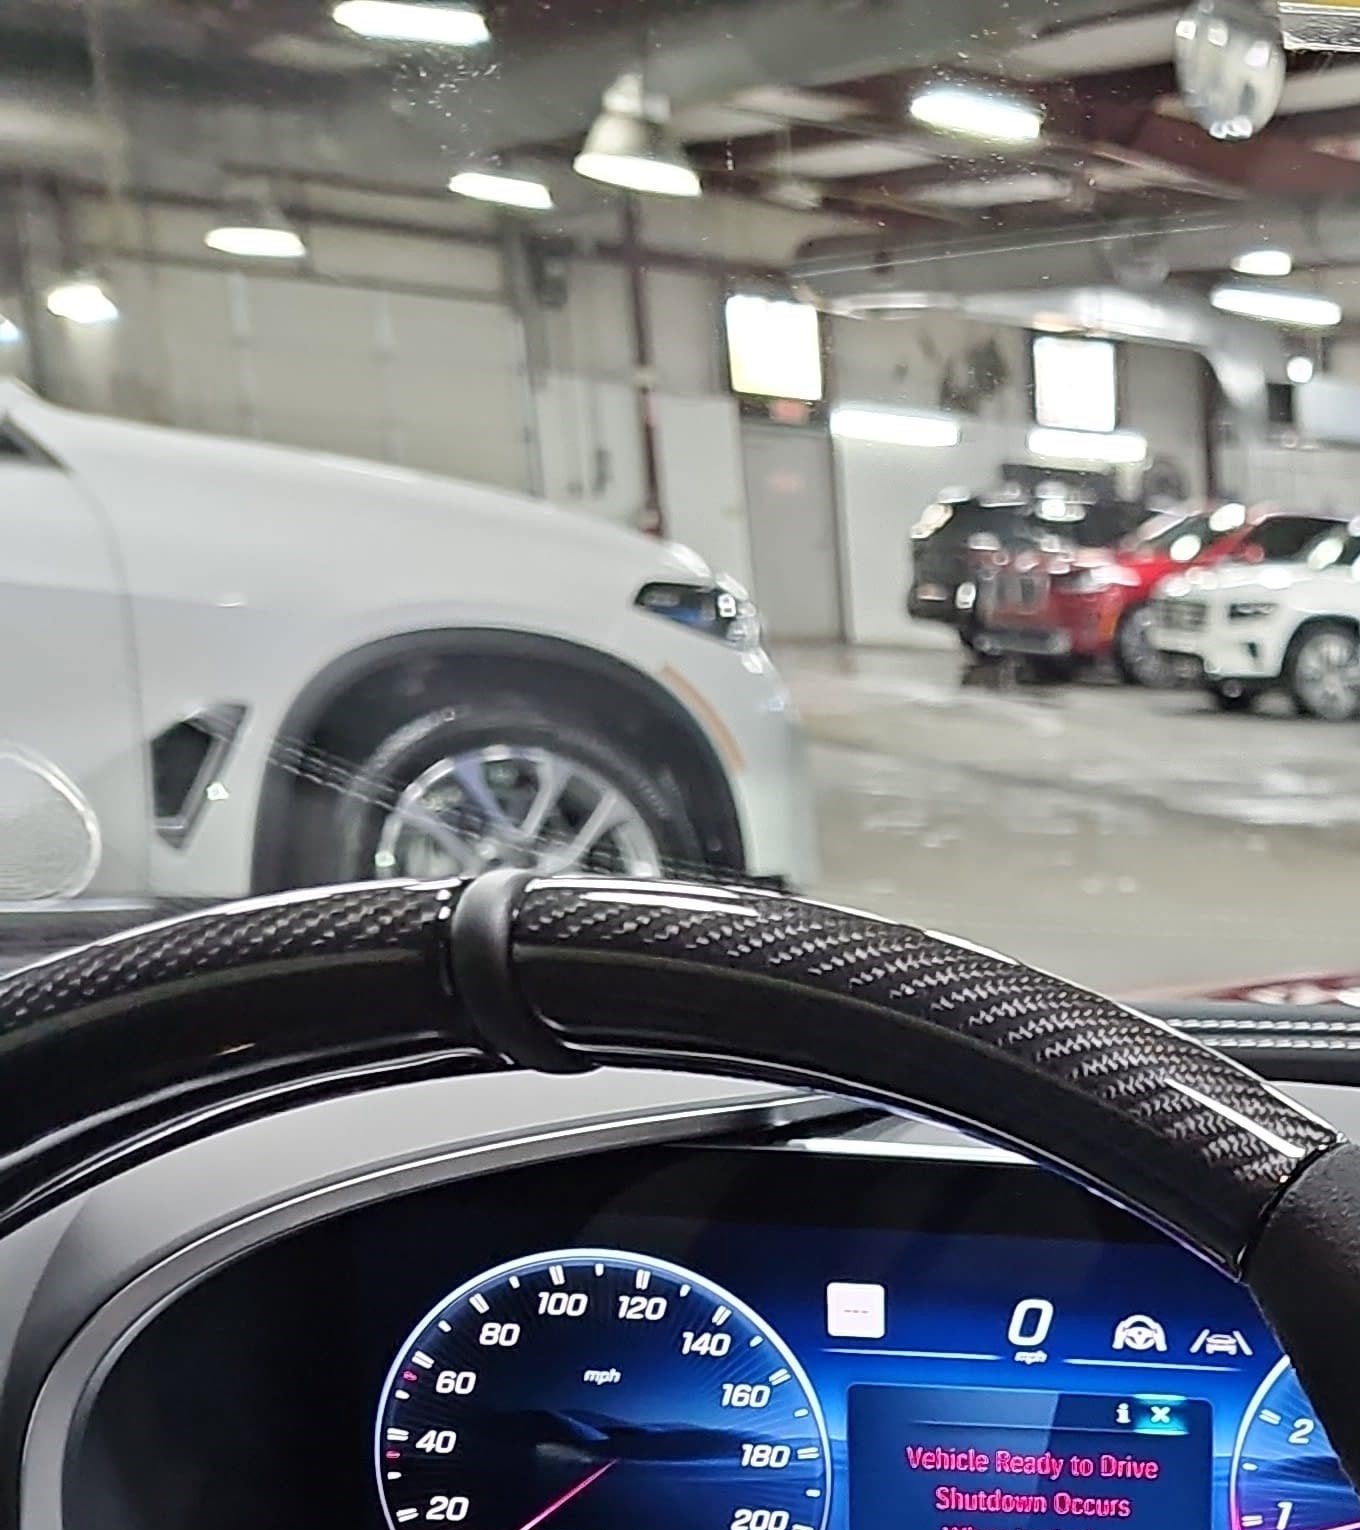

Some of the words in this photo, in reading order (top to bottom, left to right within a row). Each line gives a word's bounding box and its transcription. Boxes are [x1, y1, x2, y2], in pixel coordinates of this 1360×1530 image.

[538, 1292, 587, 1317] 100
[618, 1296, 666, 1320] 120
[479, 1323, 520, 1347] 80
[1007, 1298, 1054, 1347] 0
[682, 1332, 730, 1356] 140
[435, 1371, 476, 1395] 60
[584, 1369, 621, 1384] mph
[721, 1383, 770, 1408] 160
[416, 1431, 456, 1453] 40
[1288, 1418, 1314, 1445] 2
[741, 1444, 790, 1468] 180
[906, 1446, 989, 1472] Vehicle
[995, 1450, 1065, 1481] Ready
[1070, 1456, 1094, 1477] to
[1100, 1454, 1159, 1479] Drive
[426, 1496, 469, 1521] 20
[934, 1486, 1047, 1513] Shutdown
[1053, 1492, 1131, 1517] Occurs
[1276, 1501, 1294, 1530] 1
